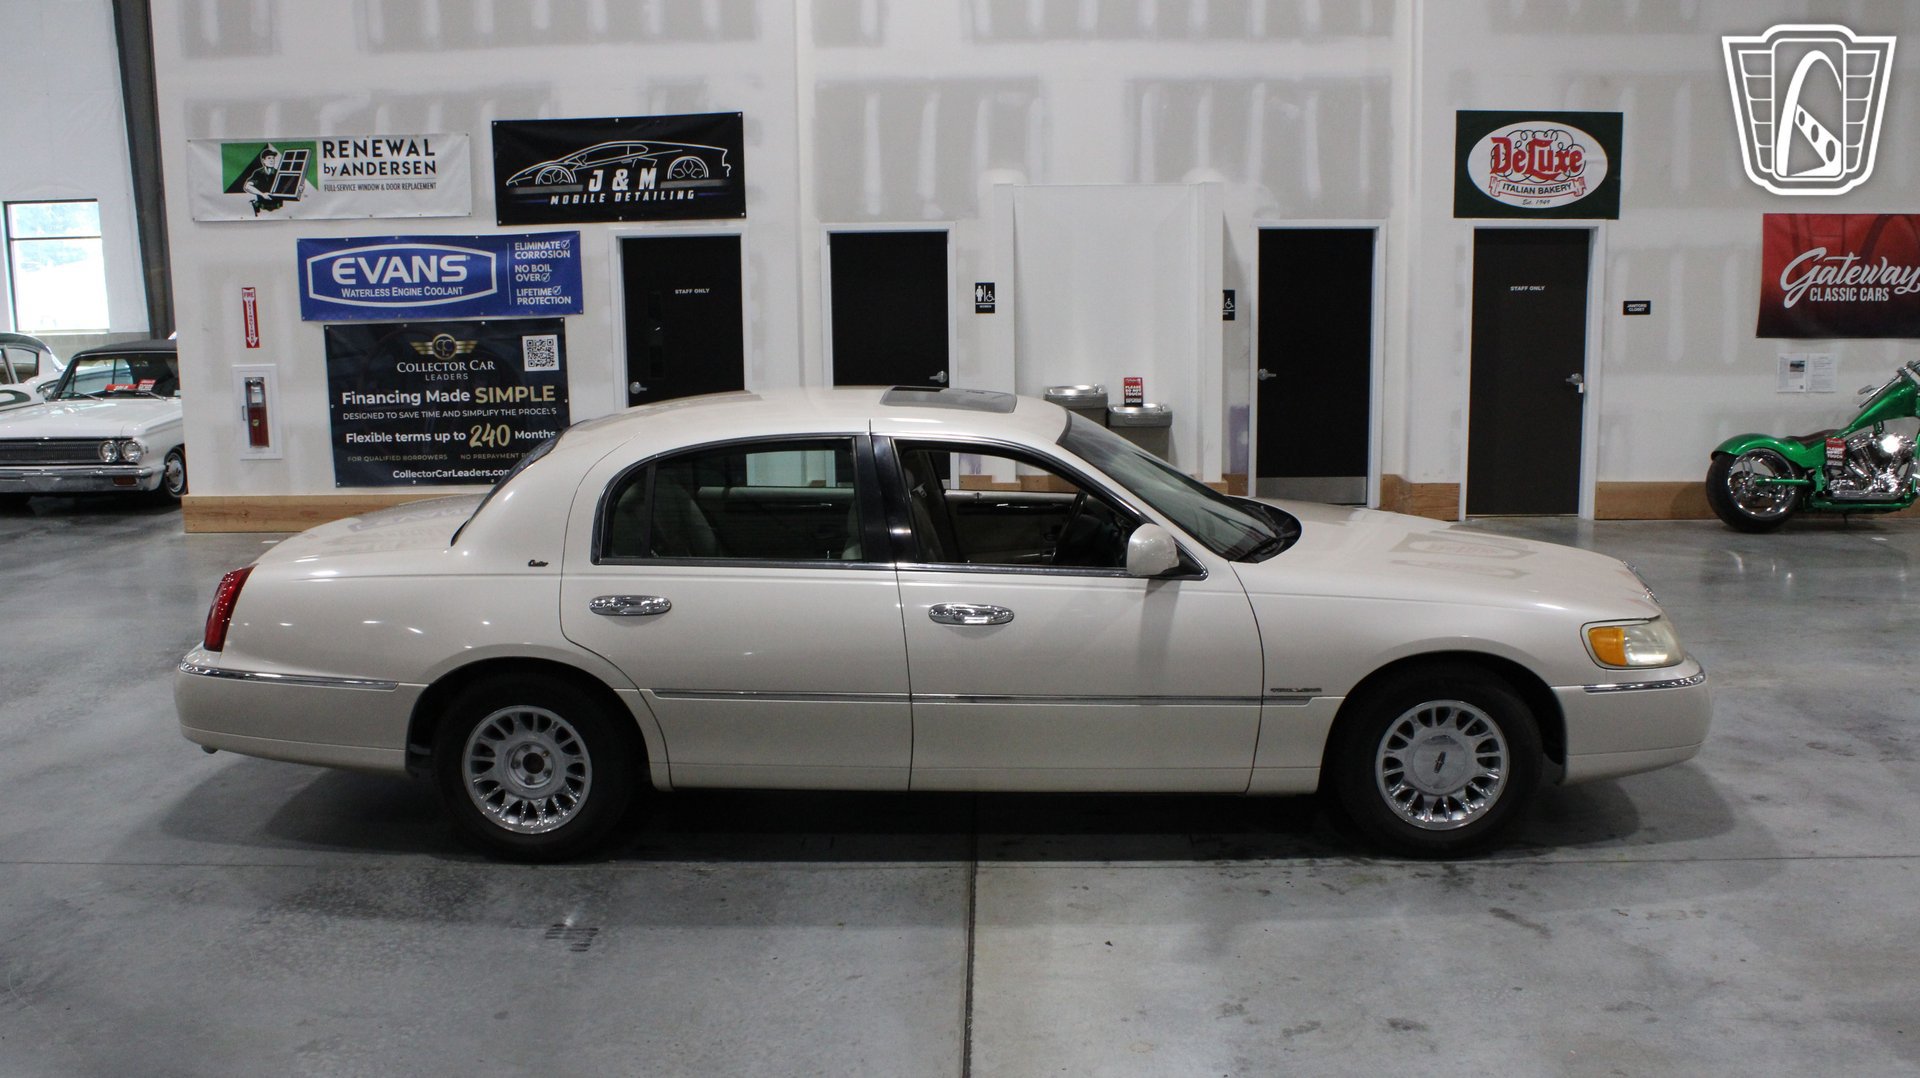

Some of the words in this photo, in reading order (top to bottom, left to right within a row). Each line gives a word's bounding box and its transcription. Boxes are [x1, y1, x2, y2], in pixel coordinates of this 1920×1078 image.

[322, 139, 436, 158] RENEWAL
[1490, 137, 1583, 180] DeLuxe
[324, 164, 336, 176] by
[340, 160, 436, 176] ANDERSEN
[402, 182, 436, 190] REPLACEMENT
[588, 170, 604, 192] J
[612, 169, 629, 191] &
[638, 168, 657, 190] M
[1502, 183, 1536, 194] ITALIAN
[1538, 183, 1572, 194] BAKERY
[550, 193, 605, 205] MOBILE
[614, 190, 694, 202] DETAILING
[515, 241, 560, 250] ELIMINATE
[515, 250, 570, 259] CORROSION
[332, 255, 468, 284] EVANS
[514, 264, 530, 273] NO
[531, 264, 552, 272] BOIL
[516, 273, 541, 282] OVER
[1780, 247, 1920, 308] Gateway
[342, 286, 390, 298] WATERLESS
[392, 286, 423, 296] ENGINE
[424, 286, 463, 296] COOLANT
[516, 288, 552, 297] LIFETIME
[1810, 287, 1857, 301] CLASSIC
[1860, 287, 1889, 301] CARS
[517, 296, 571, 305] PROTECTION
[397, 362, 467, 373] COLLECTOR
[470, 360, 495, 370] CAR
[342, 390, 421, 406] Financing
[426, 389, 470, 403] Made
[475, 385, 555, 404] SIMPLE
[346, 432, 392, 443] Flexible
[395, 432, 431, 442] terms
[434, 433, 450, 443] up
[453, 431, 466, 440] to
[469, 423, 510, 448] 240
